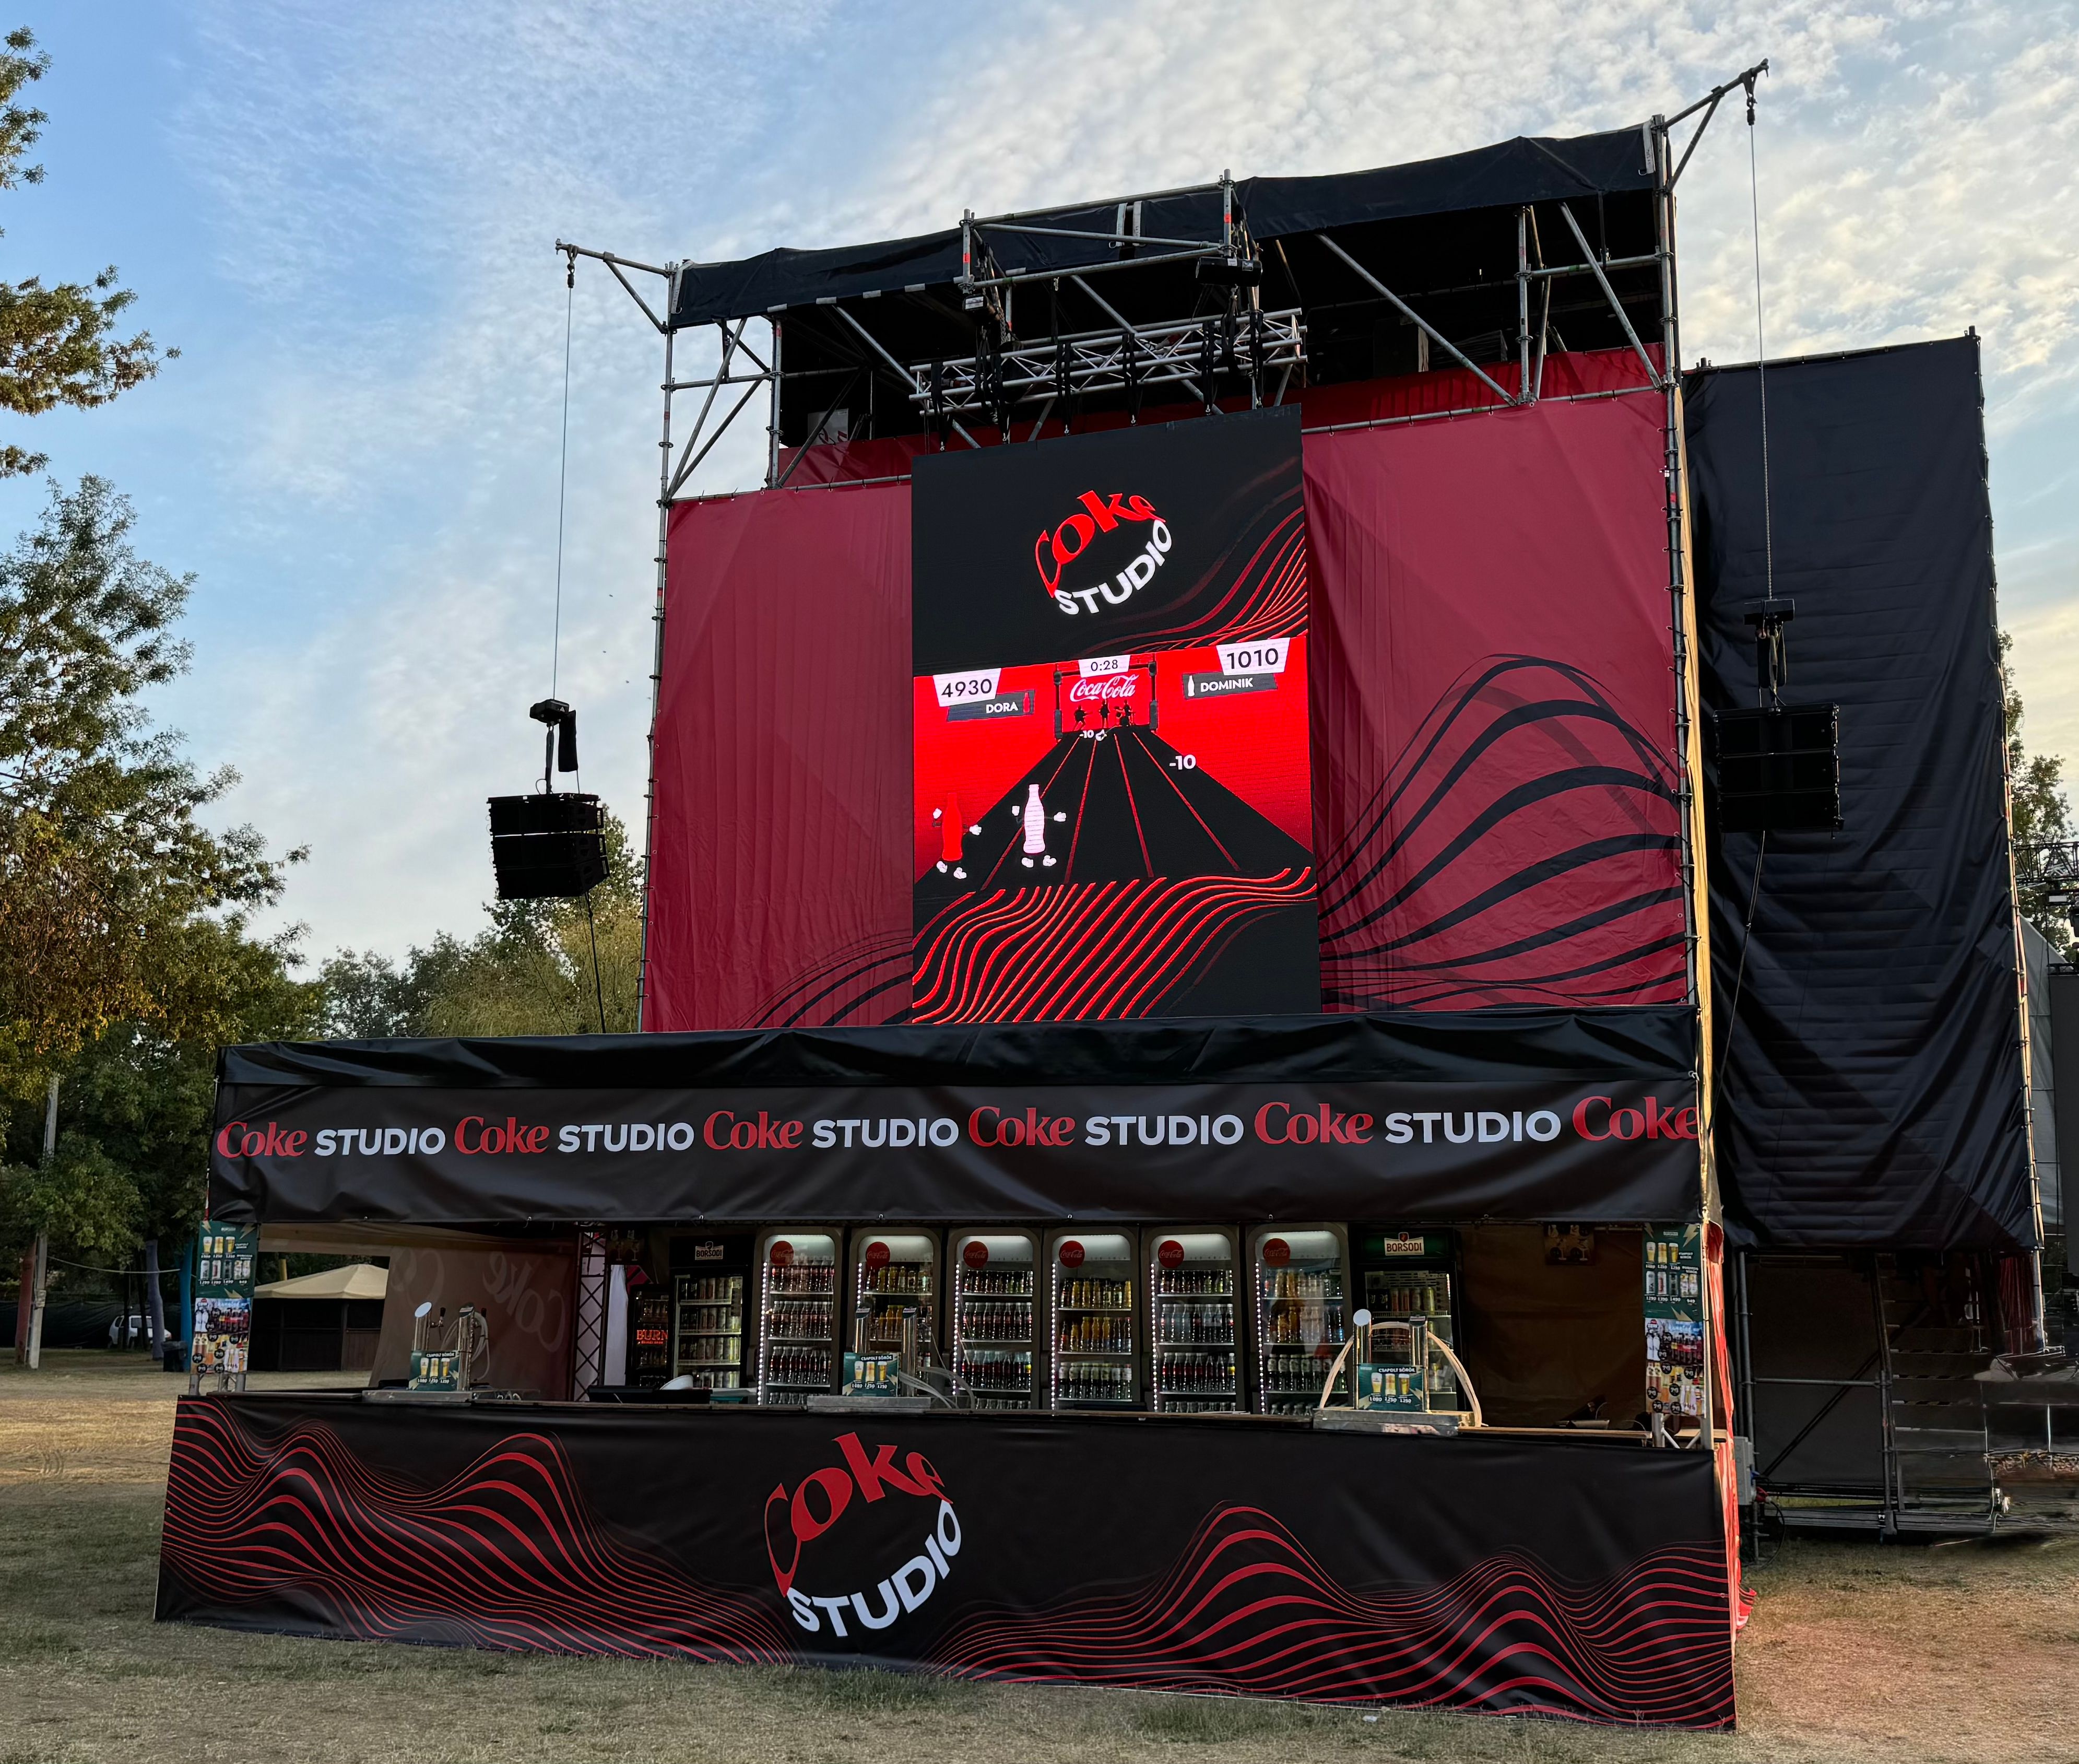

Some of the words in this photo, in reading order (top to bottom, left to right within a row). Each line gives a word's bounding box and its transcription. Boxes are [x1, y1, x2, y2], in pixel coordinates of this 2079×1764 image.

[1035, 490, 1165, 598] Coke
[1054, 519, 1172, 615] STUDIO
[1091, 660, 1118, 672] 0:28
[1227, 648, 1279, 669] 1010
[941, 678, 992, 698] 4930
[1200, 677, 1254, 692] DOMINIK
[985, 701, 1019, 714] DORA
[1079, 730, 1094, 738] -10
[1169, 754, 1196, 770] -10
[217, 1121, 308, 1158] Coke
[314, 1127, 446, 1156] STUDIO
[455, 1116, 550, 1154] Coke
[558, 1122, 694, 1153] STUDIO
[704, 1111, 804, 1150] Coke
[812, 1118, 959, 1148] STUDIO
[968, 1107, 1076, 1147] Coke
[1085, 1114, 1244, 1146] STUDIO
[1255, 1102, 1374, 1144] Coke
[1385, 1110, 1561, 1144] STUDIO
[1572, 1096, 1699, 1140] Coke
[1386, 1242, 1422, 1252] BORSODI
[636, 1330, 668, 1340] BURN
[764, 1432, 953, 1598] Coke
[786, 1499, 962, 1637] STUDIO
